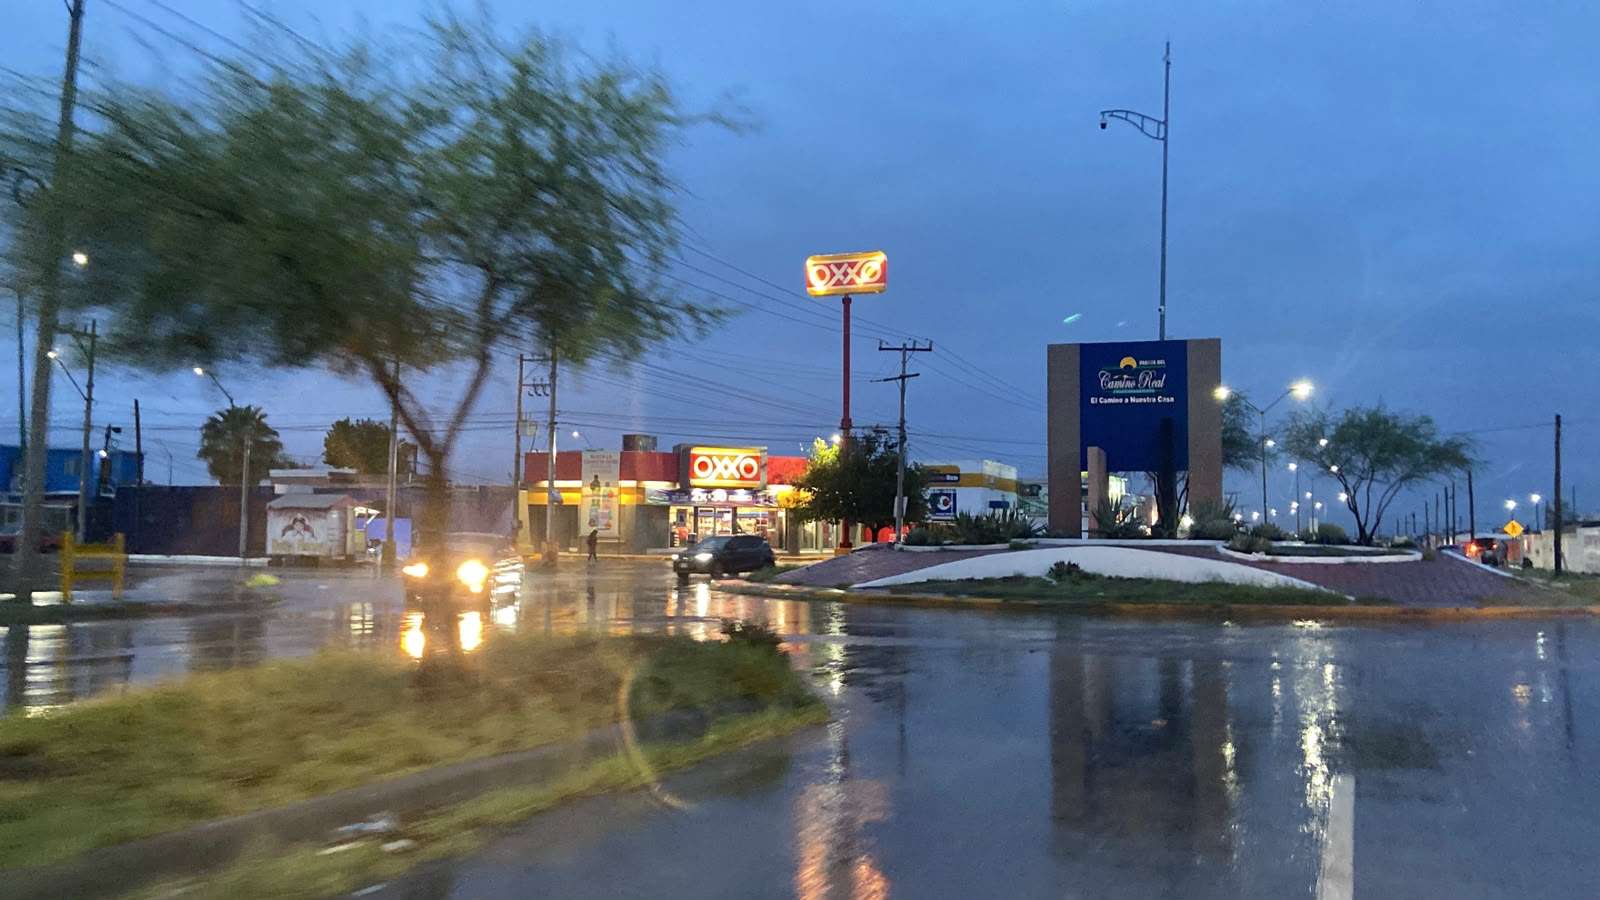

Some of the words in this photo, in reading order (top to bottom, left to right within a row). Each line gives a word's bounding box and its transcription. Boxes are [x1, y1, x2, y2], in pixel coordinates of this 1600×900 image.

[809, 260, 882, 289] OXXO
[1098, 370, 1136, 389] Camino
[1138, 370, 1167, 389] Real
[1099, 396, 1123, 404] Camino
[1157, 395, 1175, 403] Casa
[693, 455, 759, 480] OXXO
